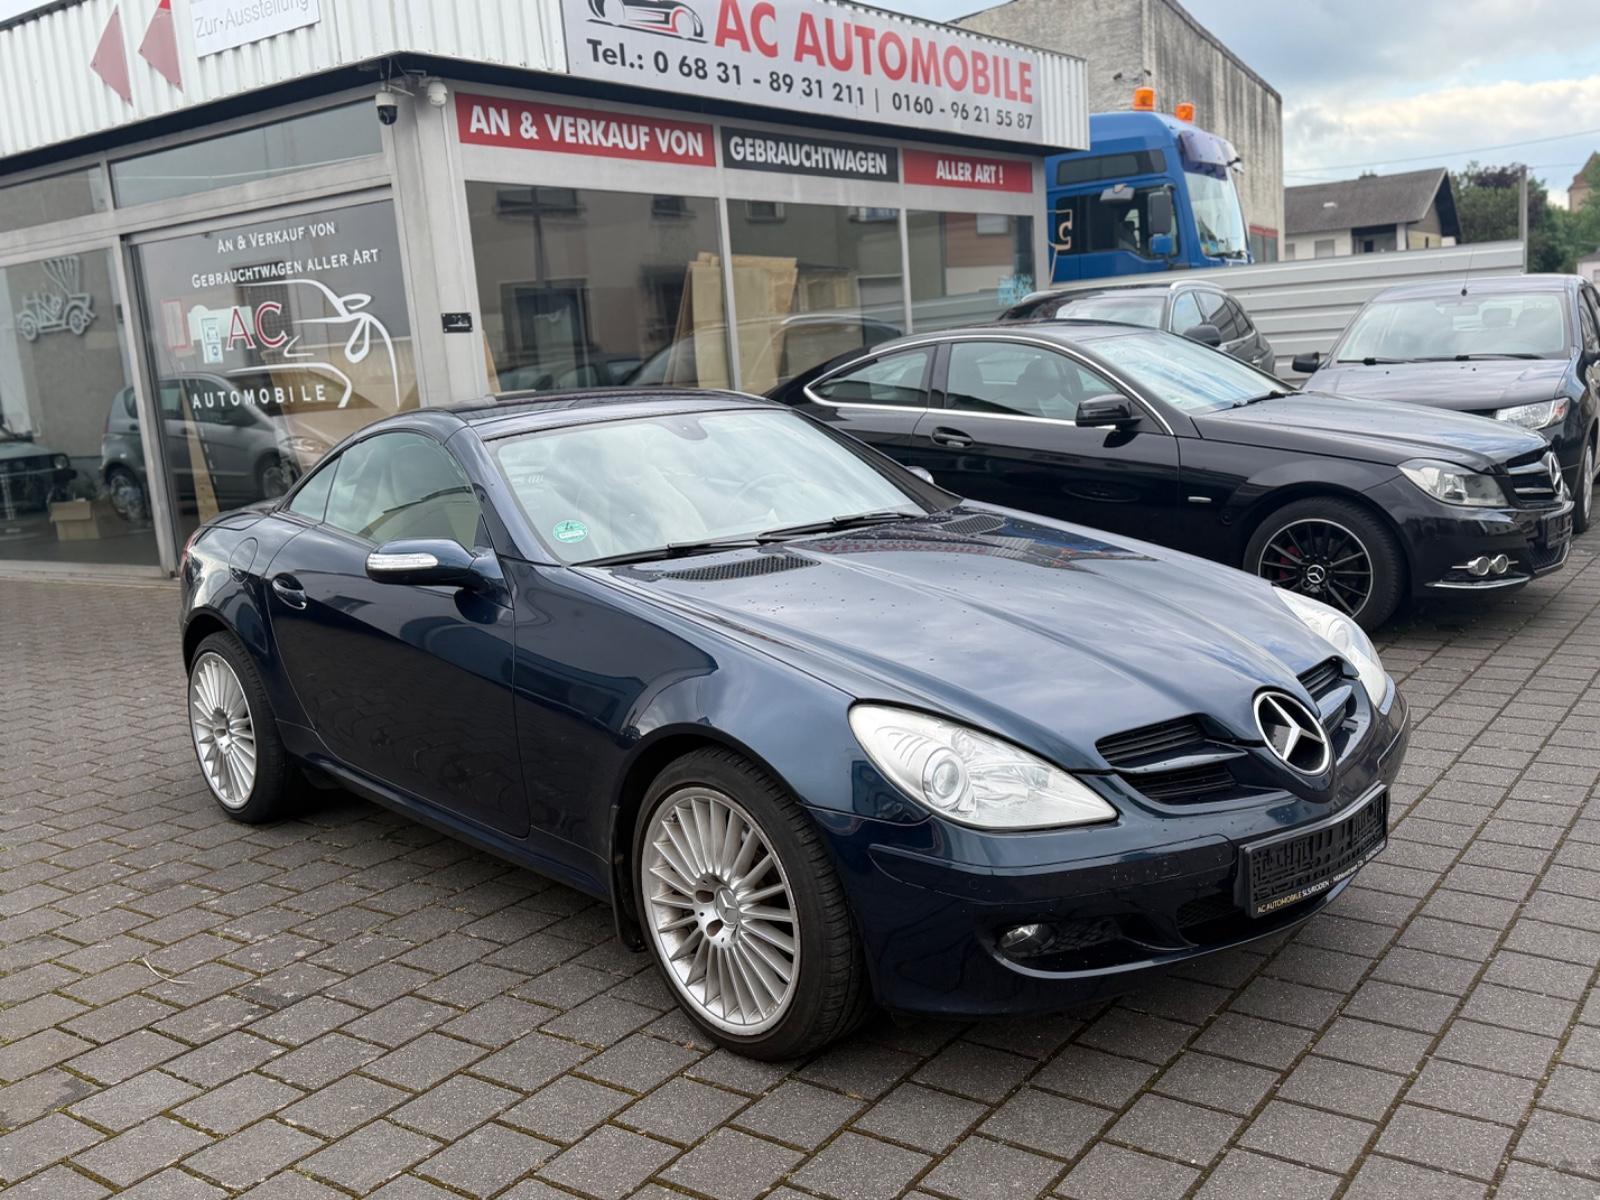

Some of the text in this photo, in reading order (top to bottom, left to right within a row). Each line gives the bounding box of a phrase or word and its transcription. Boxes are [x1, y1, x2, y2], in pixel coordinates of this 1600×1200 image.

[714, 0, 1033, 104] AC AUTOMOBILE
[586, 38, 644, 70] Tel.:
[653, 50, 669, 74] 0
[678, 55, 708, 80] 68
[716, 61, 742, 86] 31
[769, 71, 794, 94] 89
[801, 77, 823, 99] 31
[832, 82, 864, 106] 211
[892, 92, 934, 115] 0160
[951, 101, 969, 120] 96
[974, 106, 990, 124] 21
[996, 110, 1013, 127] 55
[1017, 112, 1033, 130] 87
[469, 105, 704, 157] AN & VERKAUF VON
[729, 136, 887, 175] GEBRAUCHTWAGEN
[935, 159, 972, 183] ALLER
[237, 235, 246, 250] &
[225, 301, 289, 350] AC
[193, 384, 326, 409] AUTOMOBILE
[1266, 891, 1302, 910] AUTOMOBILE
